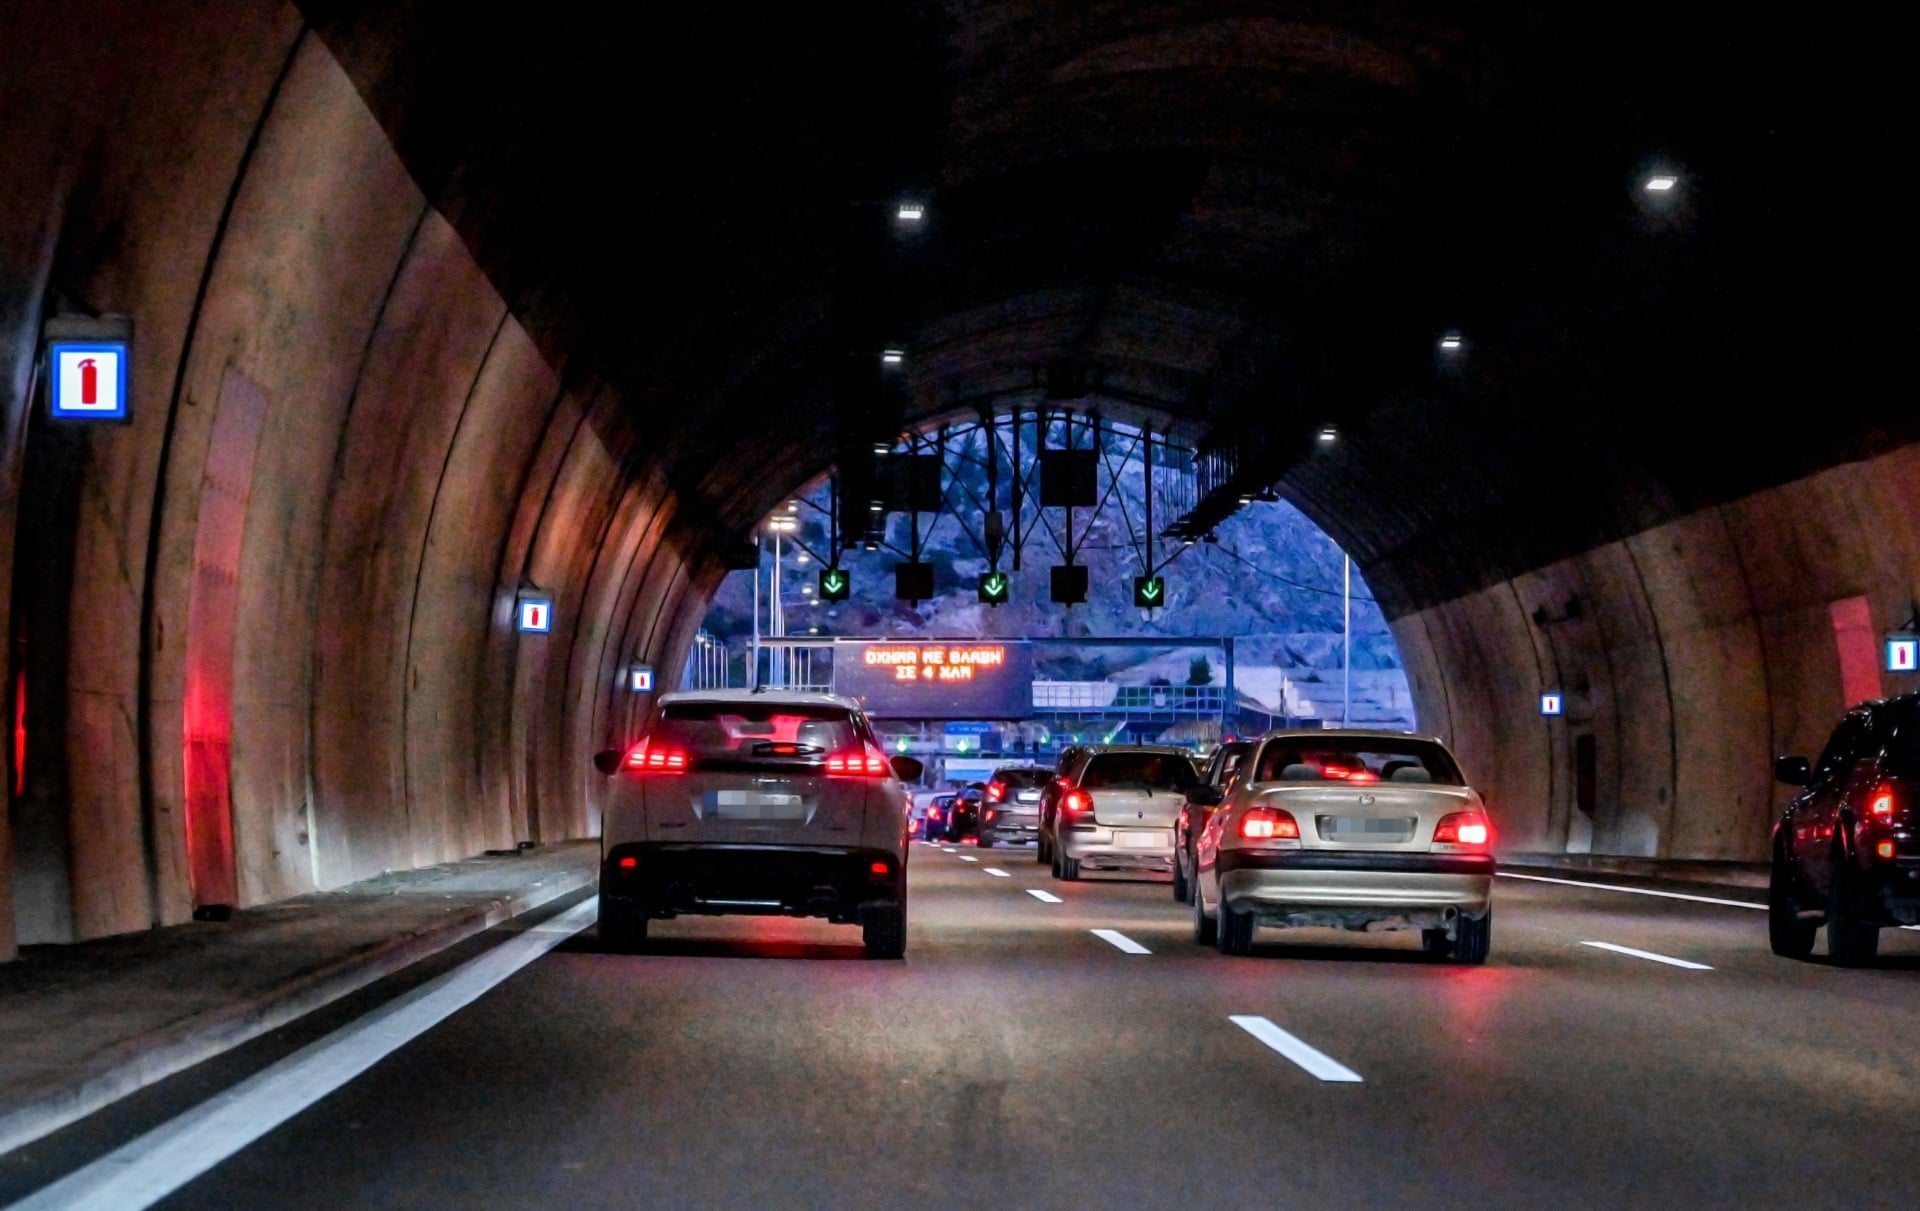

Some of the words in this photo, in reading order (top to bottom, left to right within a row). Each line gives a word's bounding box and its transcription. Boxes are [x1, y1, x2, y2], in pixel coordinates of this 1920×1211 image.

[922, 650, 944, 664] ΜΕ
[949, 650, 1001, 664] ΒΛΑΒΗ
[896, 665, 917, 679] ΣΕ
